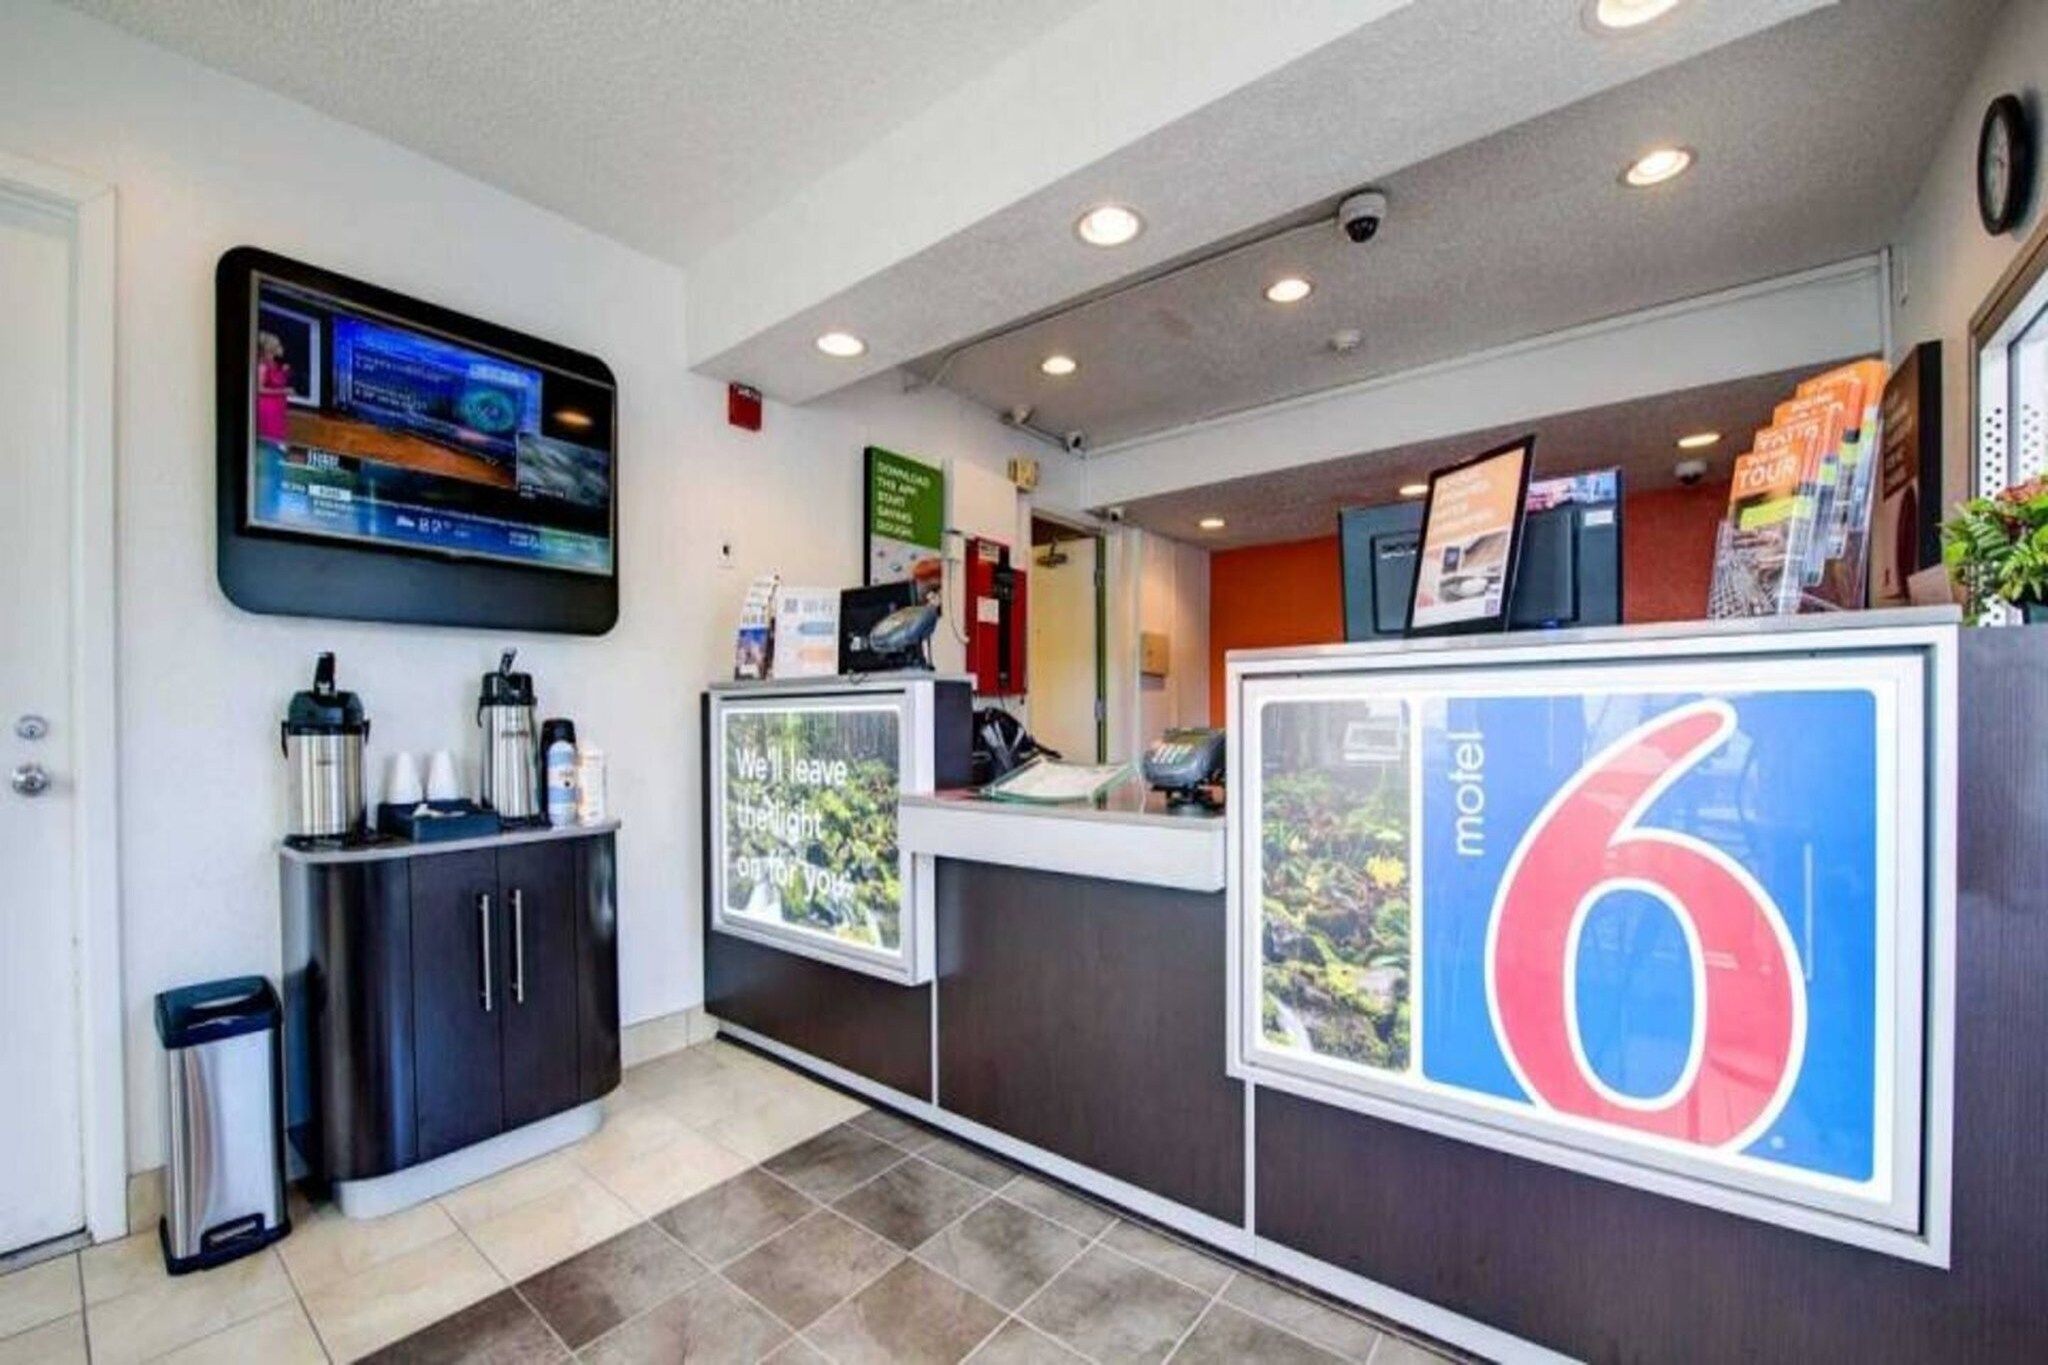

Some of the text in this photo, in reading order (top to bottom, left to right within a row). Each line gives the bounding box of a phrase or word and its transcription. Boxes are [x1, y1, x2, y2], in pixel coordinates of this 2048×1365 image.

[736, 747, 847, 785] We'll leave
[737, 798, 823, 845] the light
[737, 855, 761, 879] on
[768, 849, 798, 888] for
[1447, 698, 1808, 1155] motel 6
